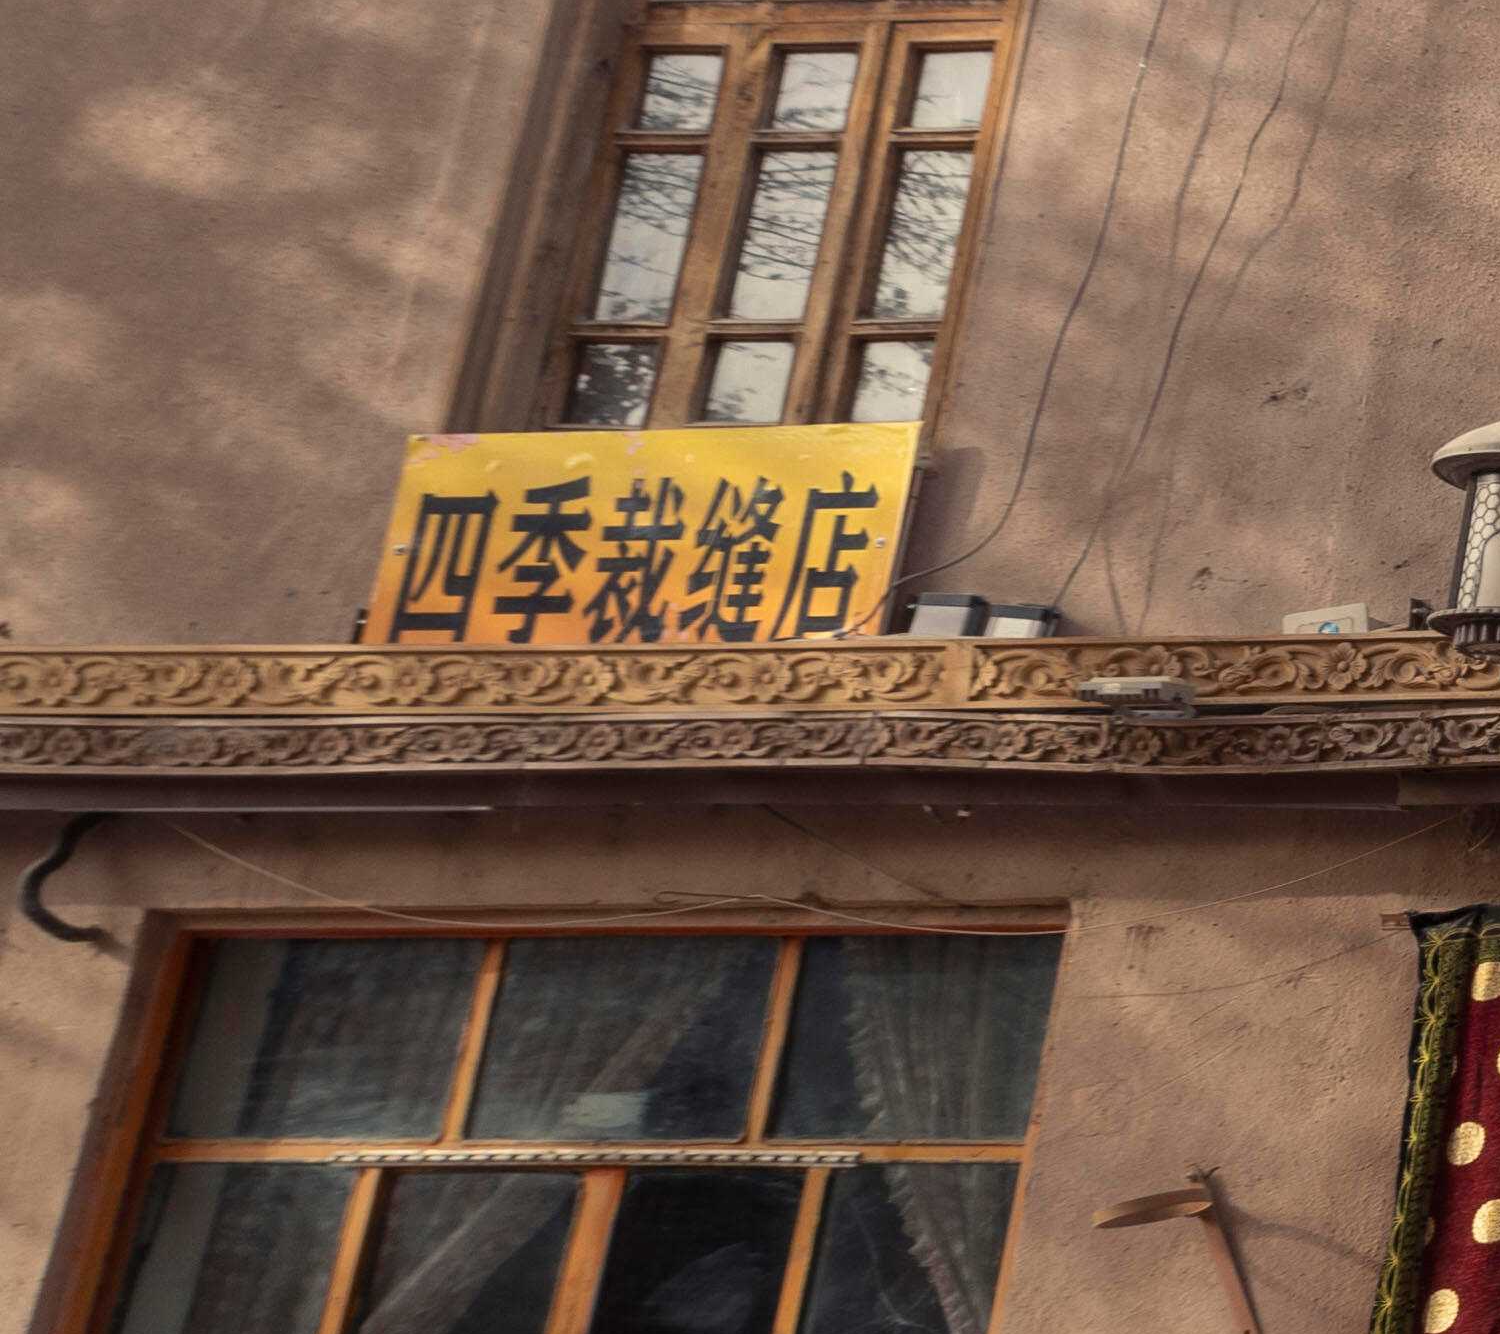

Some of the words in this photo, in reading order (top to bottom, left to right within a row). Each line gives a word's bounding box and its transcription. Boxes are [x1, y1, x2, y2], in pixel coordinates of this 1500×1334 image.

[389, 470, 879, 644] 四季裁缝店
